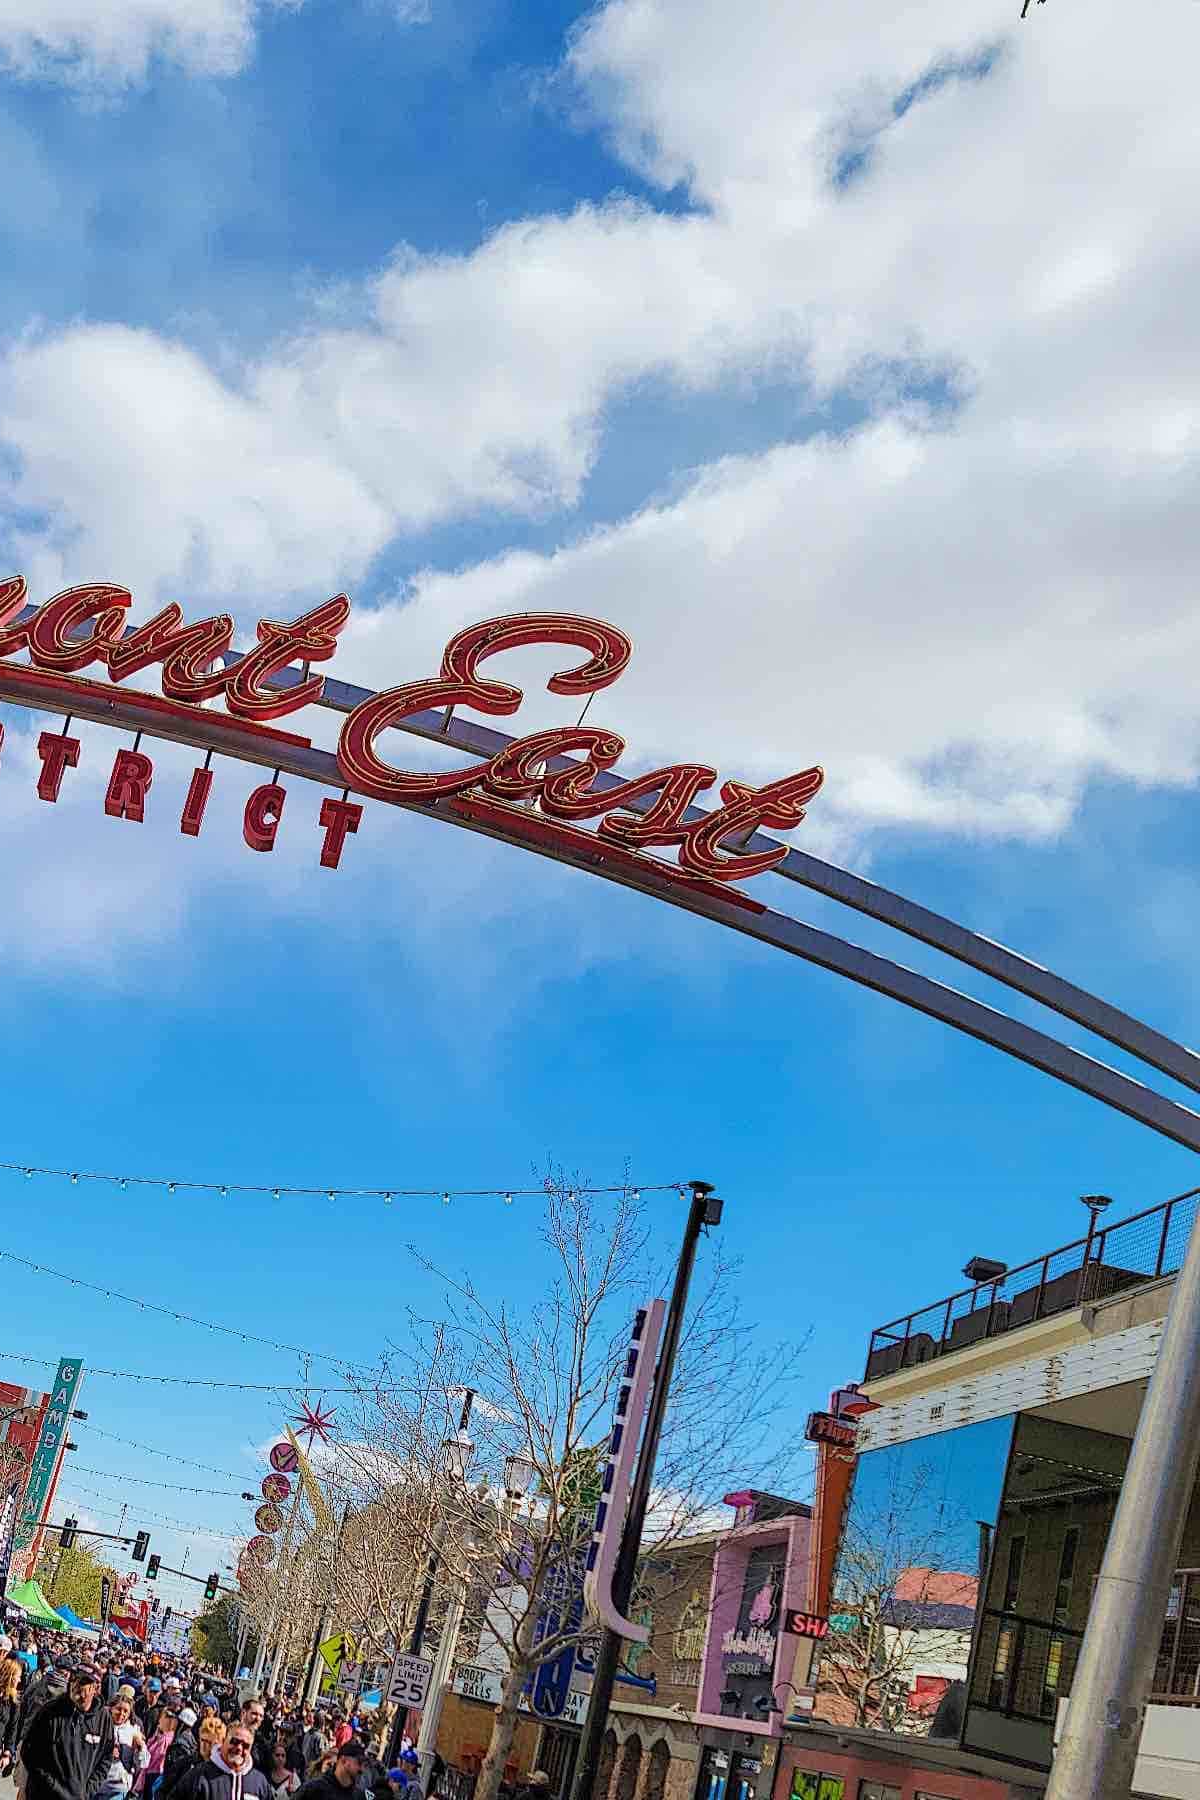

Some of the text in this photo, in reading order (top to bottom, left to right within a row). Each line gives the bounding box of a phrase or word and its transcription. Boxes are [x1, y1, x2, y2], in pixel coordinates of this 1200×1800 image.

[337, 611, 825, 882] East
[22, 1364, 76, 1516] GAMBLIN
[397, 1658, 430, 1674] SPEED
[399, 1668, 424, 1682] LIMIT
[390, 1679, 424, 1703] 25
[461, 1683, 492, 1700] BALLS
